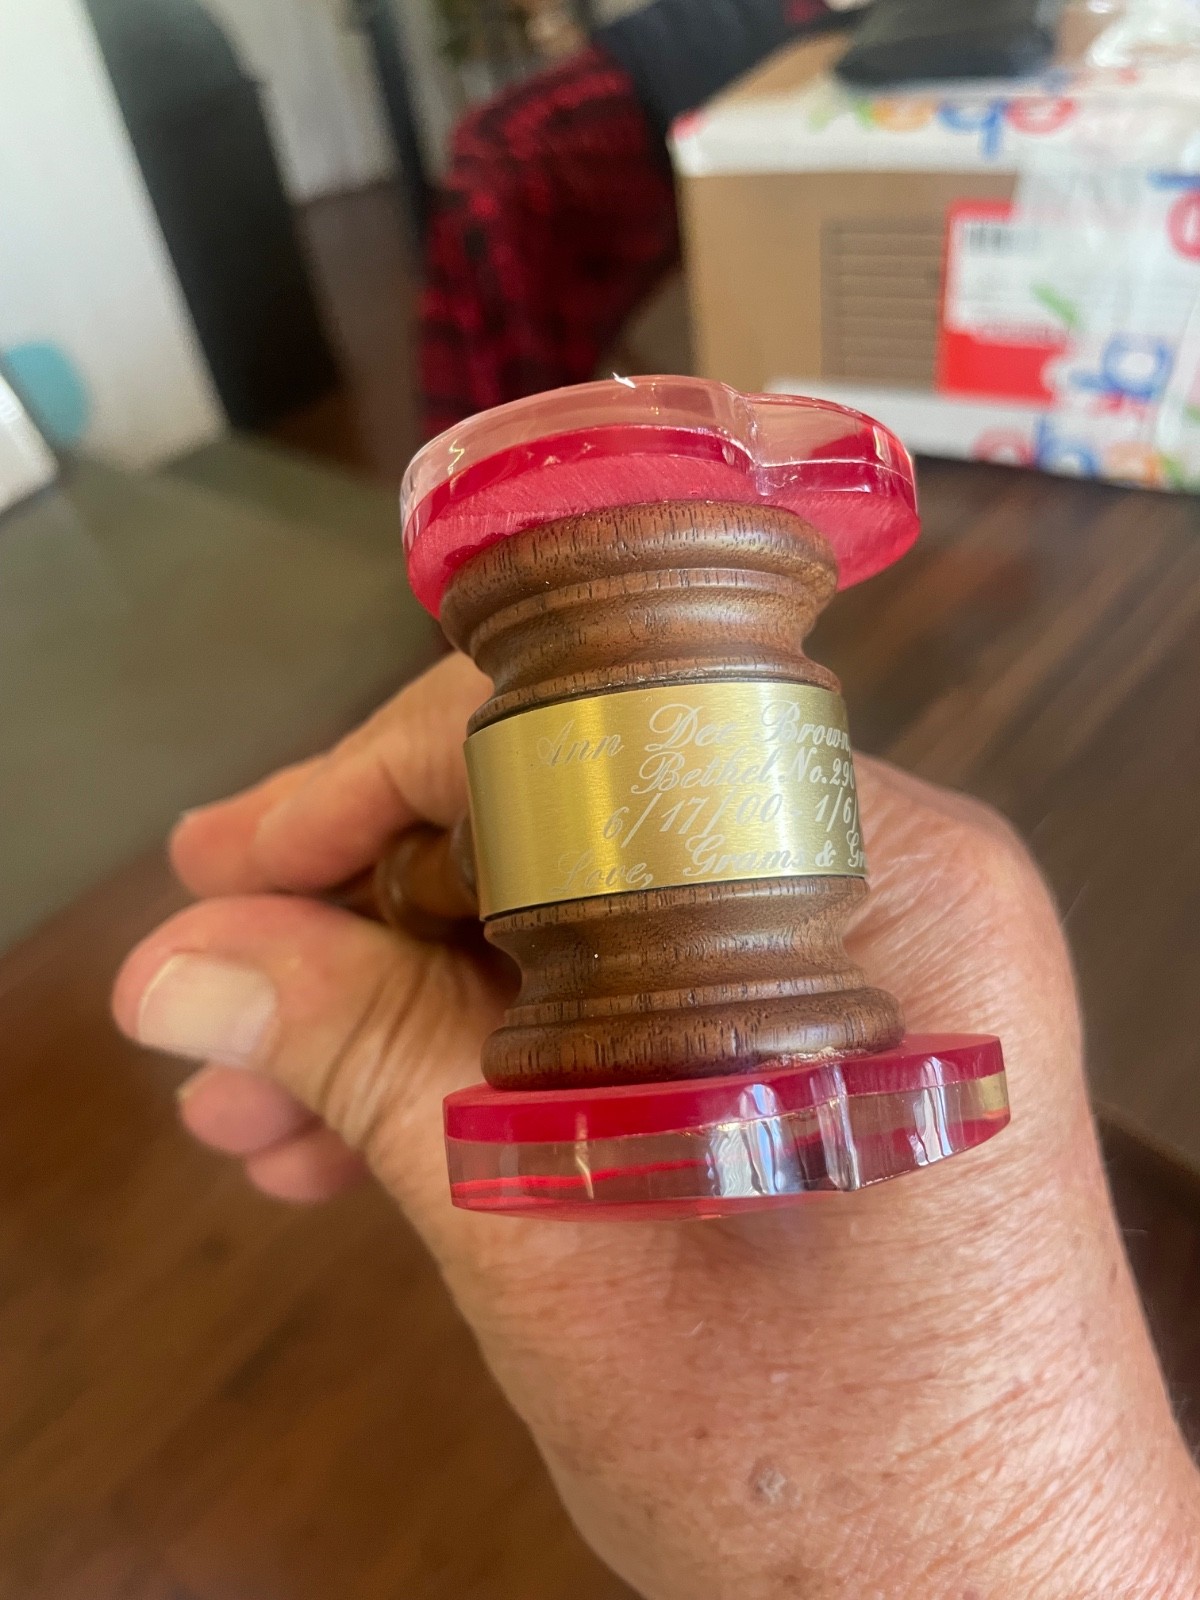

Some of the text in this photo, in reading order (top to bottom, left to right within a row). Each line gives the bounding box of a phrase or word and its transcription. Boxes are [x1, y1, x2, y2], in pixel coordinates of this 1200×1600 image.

[537, 719, 624, 767] Ann
[645, 703, 738, 752] Dee
[631, 748, 782, 795] Bethel
[553, 849, 654, 892] Love,
[683, 834, 804, 877] Grams
[814, 839, 837, 868] &
